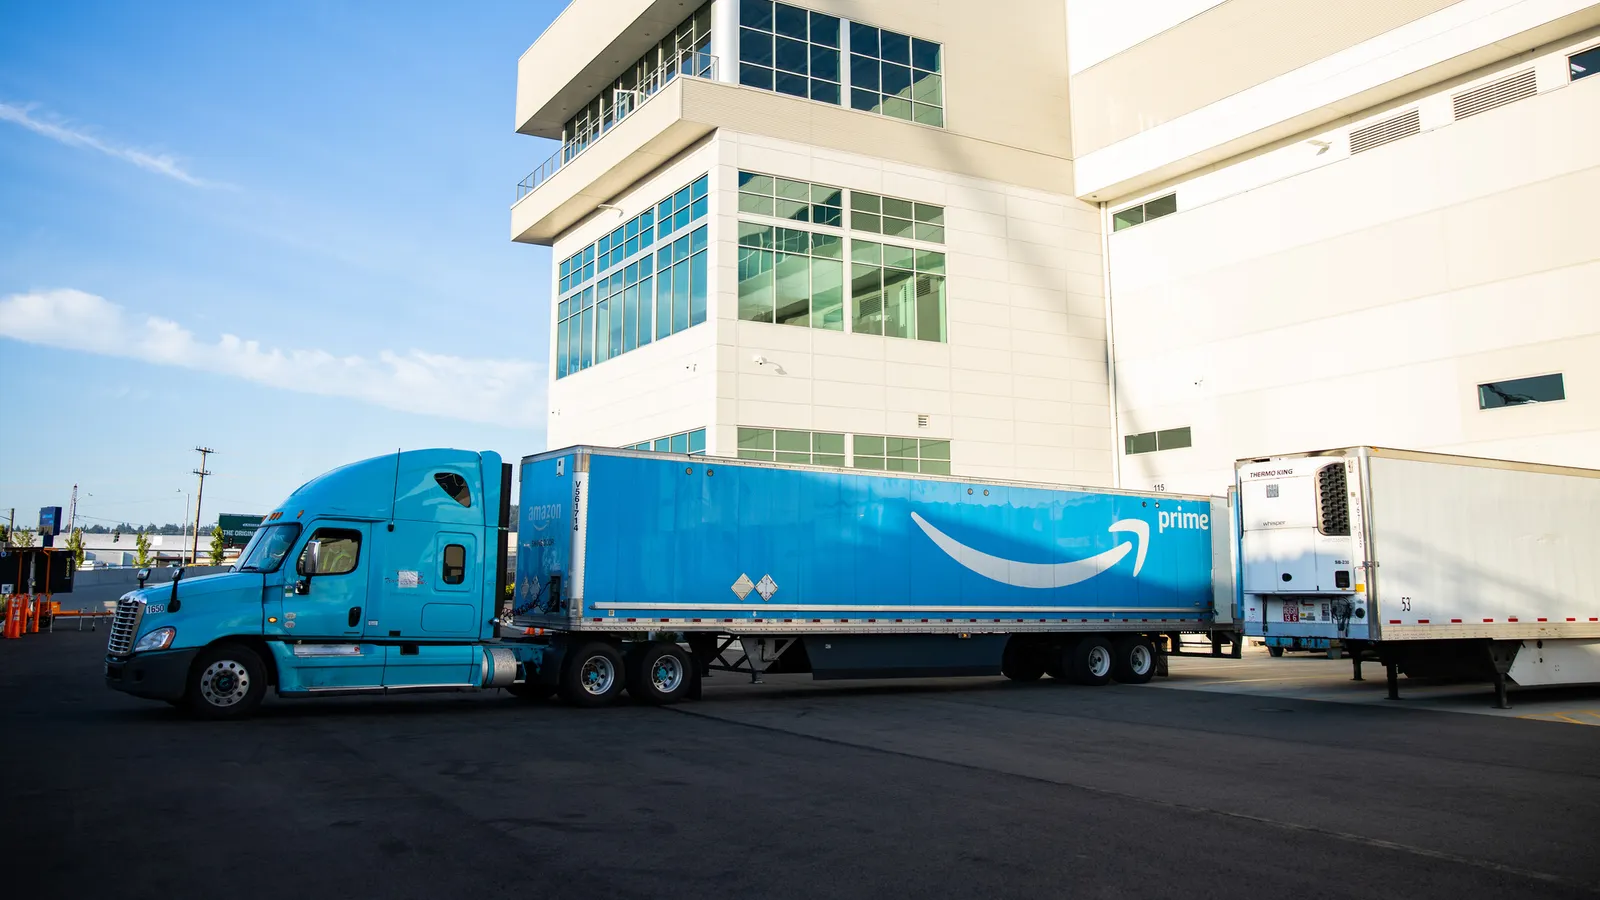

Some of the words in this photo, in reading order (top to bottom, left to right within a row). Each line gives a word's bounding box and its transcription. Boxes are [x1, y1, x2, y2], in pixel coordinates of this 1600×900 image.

[1250, 470, 1276, 478] THERMO
[1153, 484, 1165, 492] 115
[529, 504, 561, 520] amazon
[1159, 506, 1208, 533] prime
[223, 529, 234, 537] THE
[235, 529, 257, 537] ORIGIN
[147, 604, 165, 614] 1650
